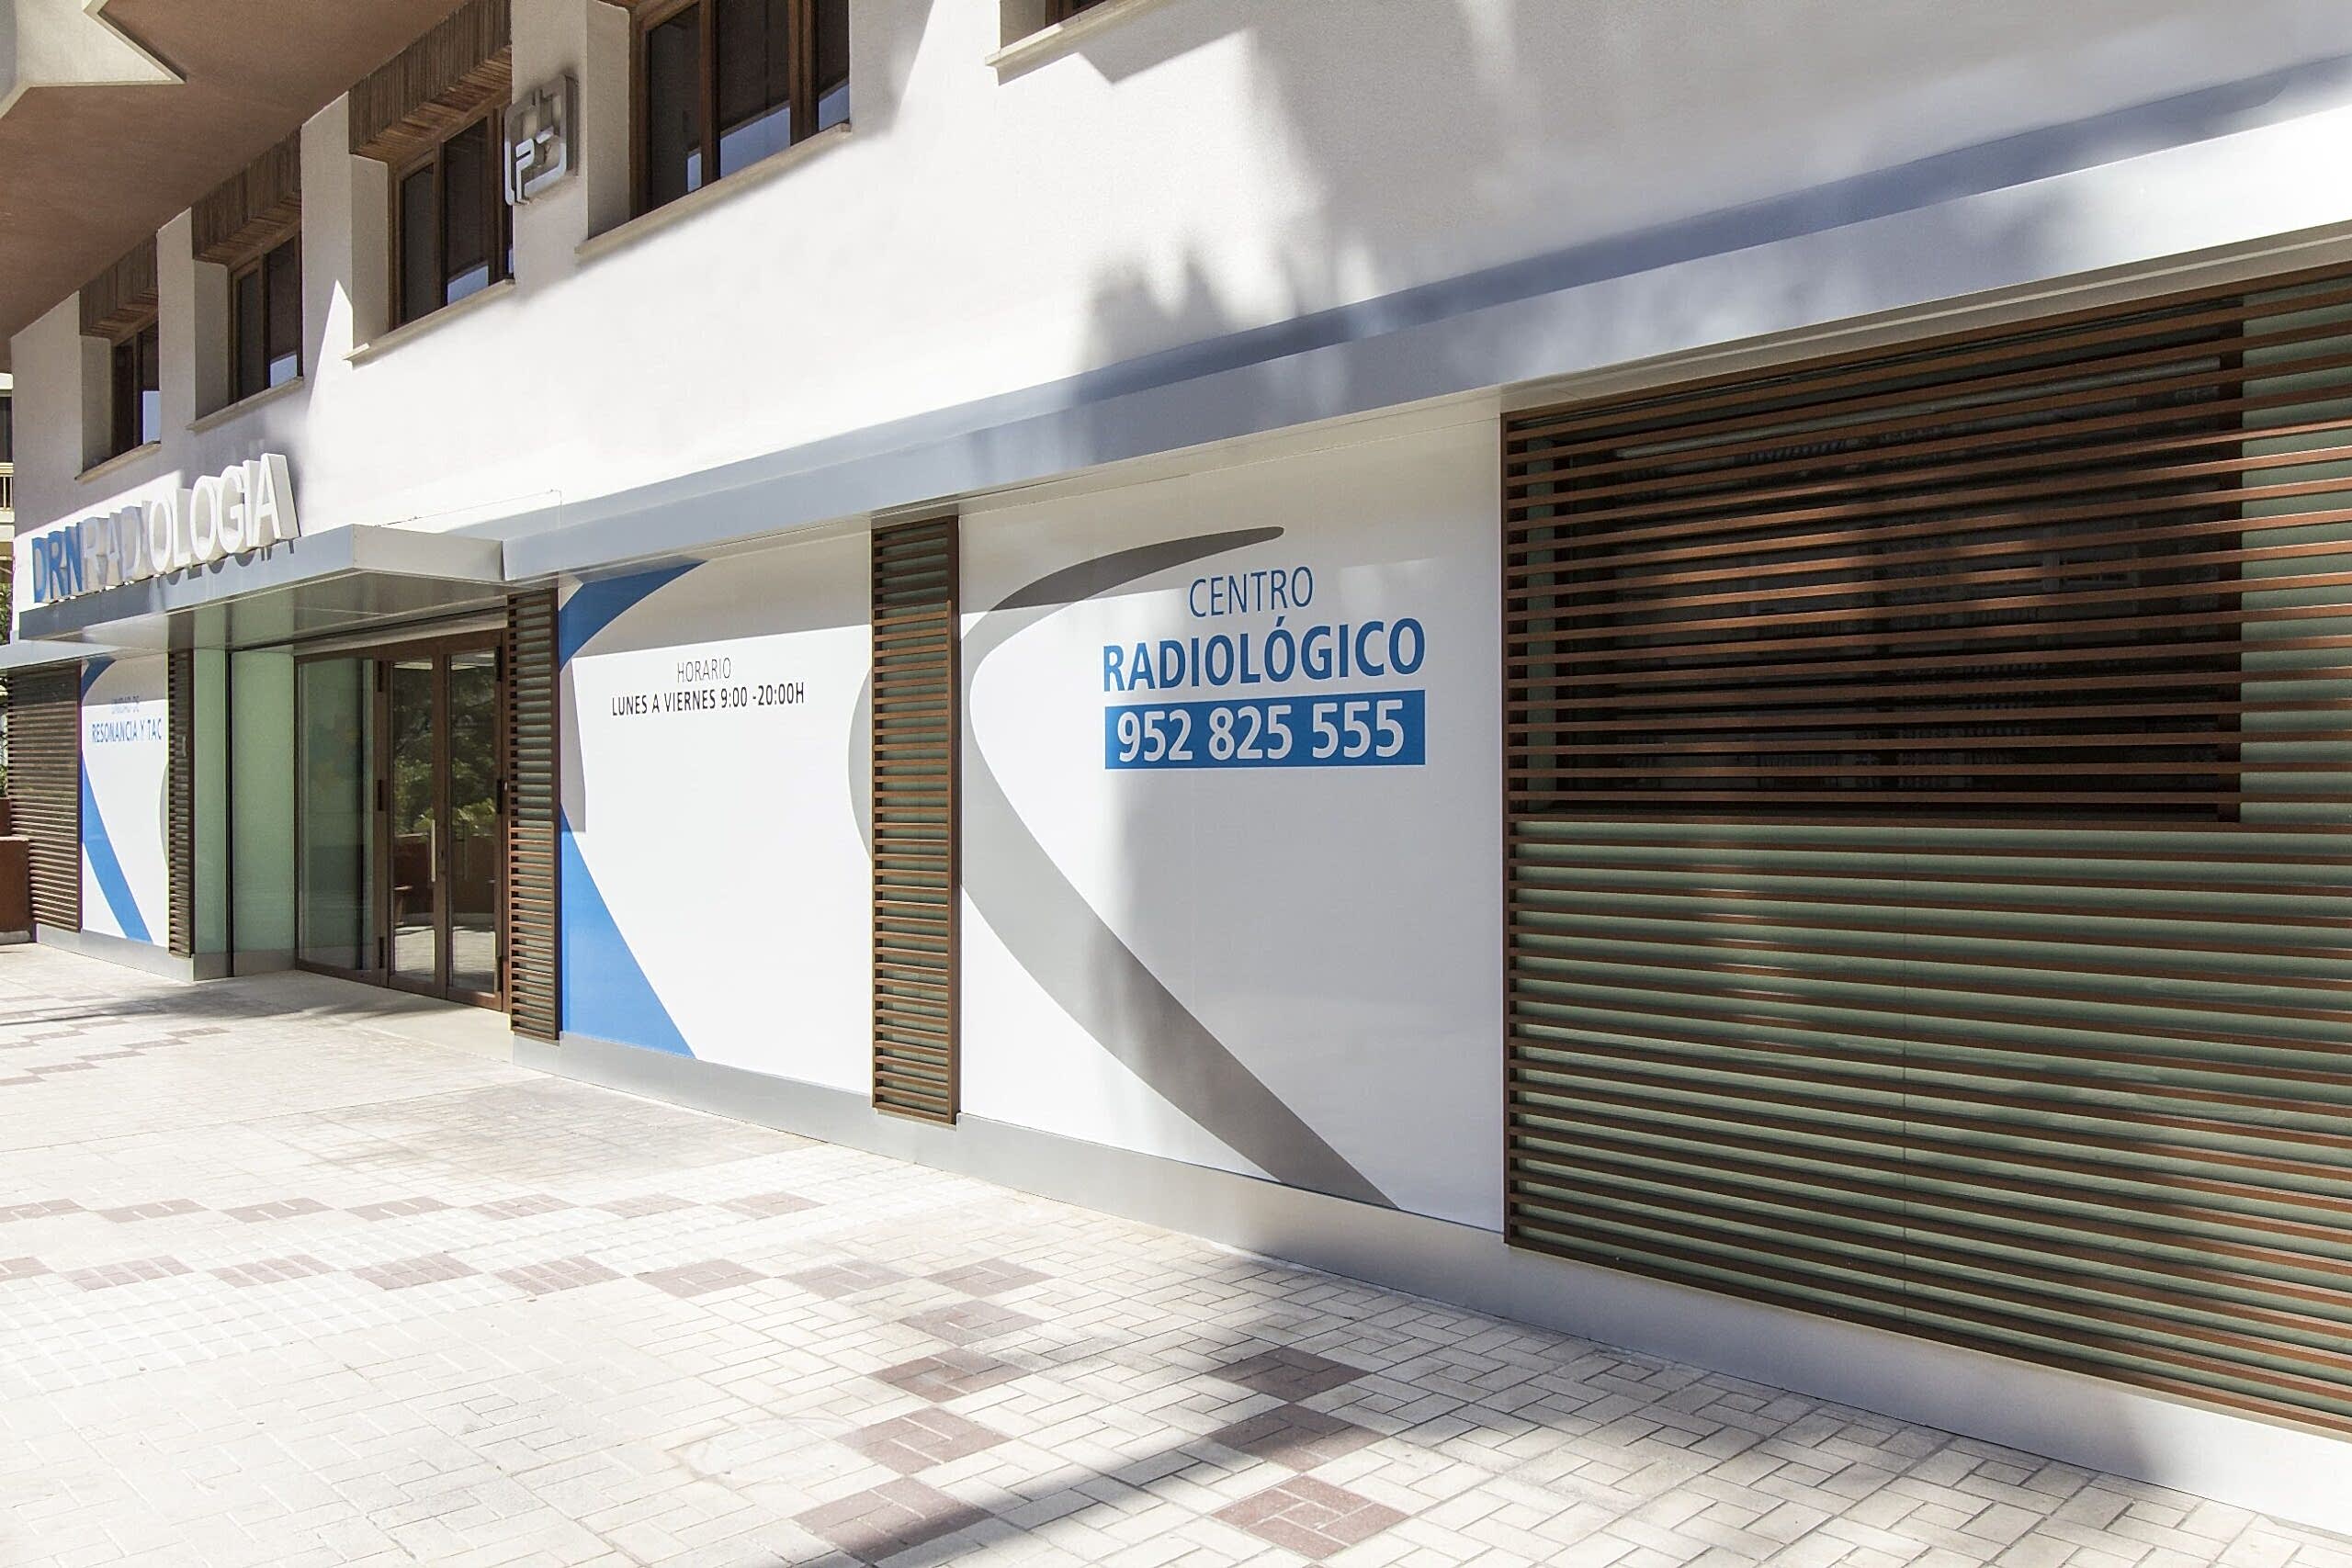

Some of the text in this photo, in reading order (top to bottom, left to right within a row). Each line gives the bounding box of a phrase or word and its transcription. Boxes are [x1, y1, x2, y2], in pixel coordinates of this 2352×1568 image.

[1189, 566, 1314, 618] CENTRO
[677, 657, 732, 683] HORARIO
[1102, 616, 1426, 693] RADIOLÓGICO
[611, 695, 649, 716] LUNES
[651, 694, 661, 714] A
[663, 689, 717, 713] VIERNES
[720, 686, 748, 708] 9:00
[91, 717, 163, 743] RESONANCIA Y TAC
[1116, 698, 1405, 763] 952 825 555
